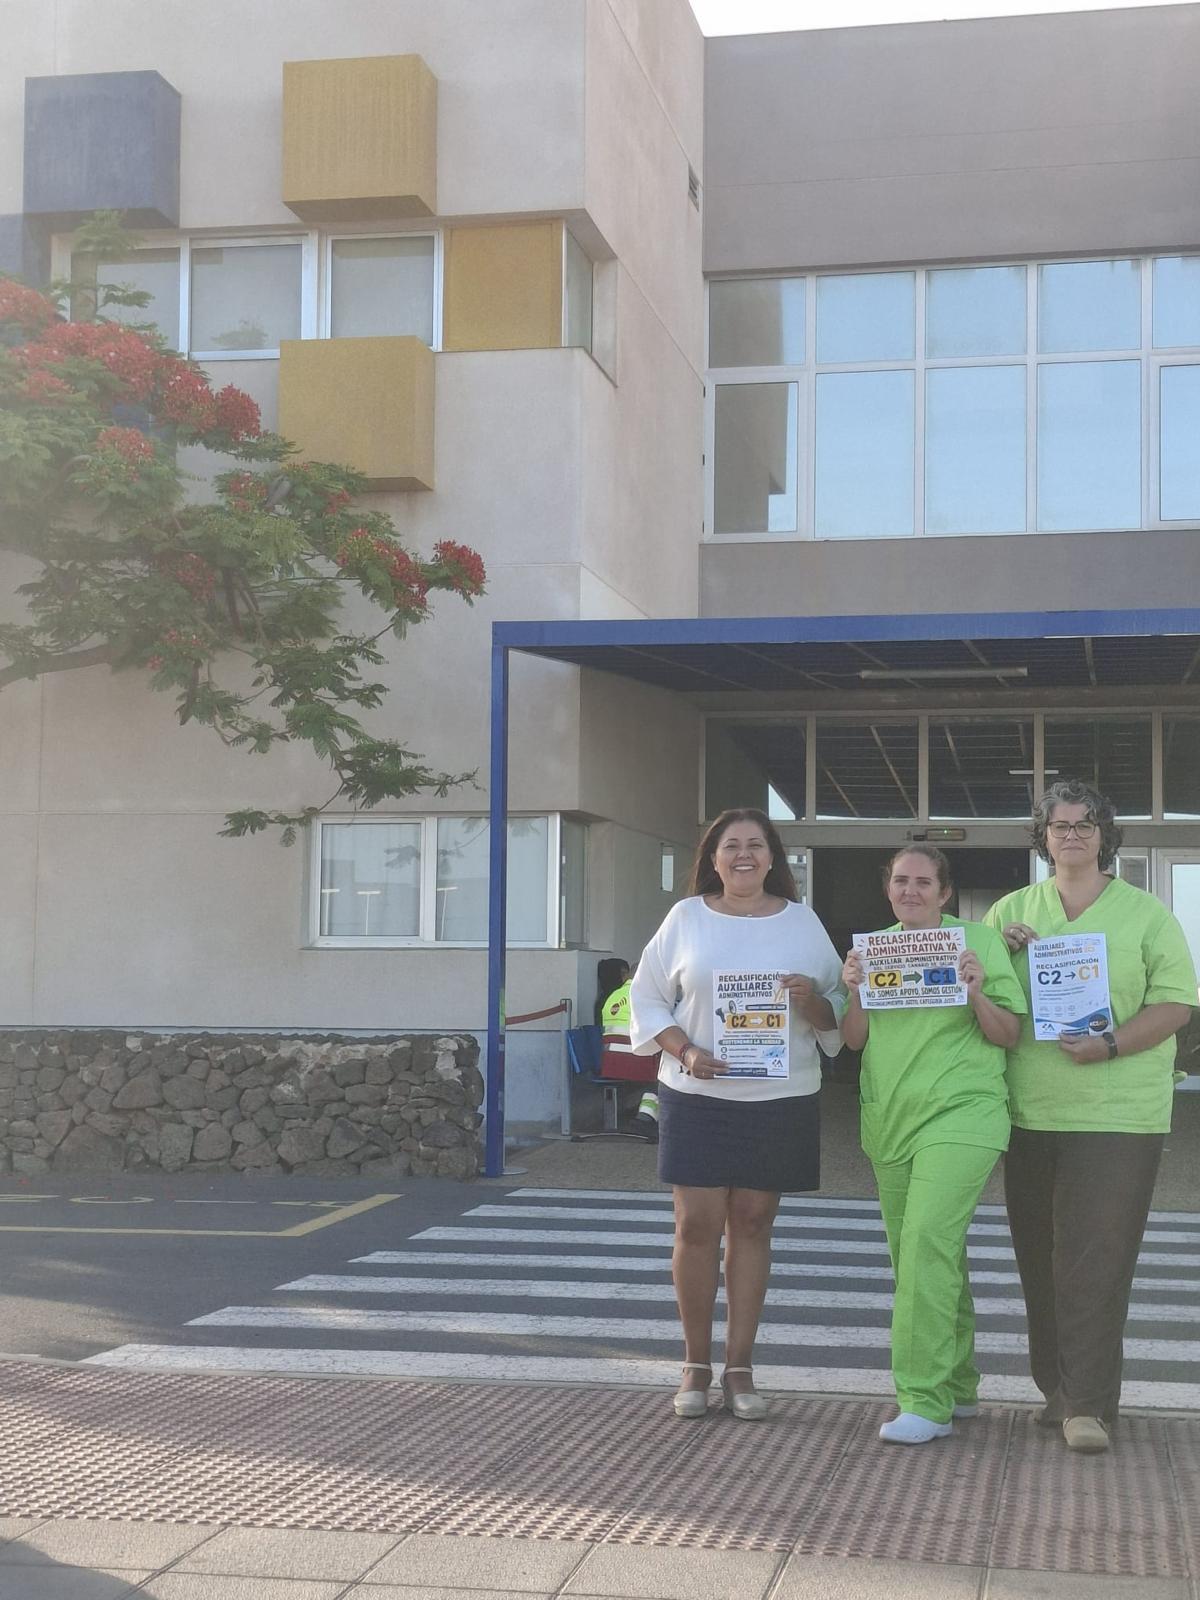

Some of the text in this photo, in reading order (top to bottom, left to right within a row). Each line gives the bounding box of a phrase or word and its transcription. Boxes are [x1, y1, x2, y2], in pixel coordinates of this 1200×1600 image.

[868, 931, 951, 946] RECLASIFICACIÓN
[866, 942, 958, 957] ADMINISTRATIVA YA
[1034, 942, 1065, 951] AUXILIARES
[1034, 947, 1083, 958] ADMINISTRATIVOS
[869, 954, 958, 966] AUXILIAR ADMINISTRATIVO
[1036, 957, 1099, 970] RECLASIFICACIÓN
[874, 969, 952, 987] C2 C1
[1038, 964, 1100, 985] C2 C1
[718, 982, 773, 992] AUXILIARES
[921, 987, 940, 995] SOMOS
[942, 985, 962, 994] GESTIÓN
[719, 991, 773, 999] ADMINISTRATIVOS
[731, 1014, 780, 1028] C2 C1
